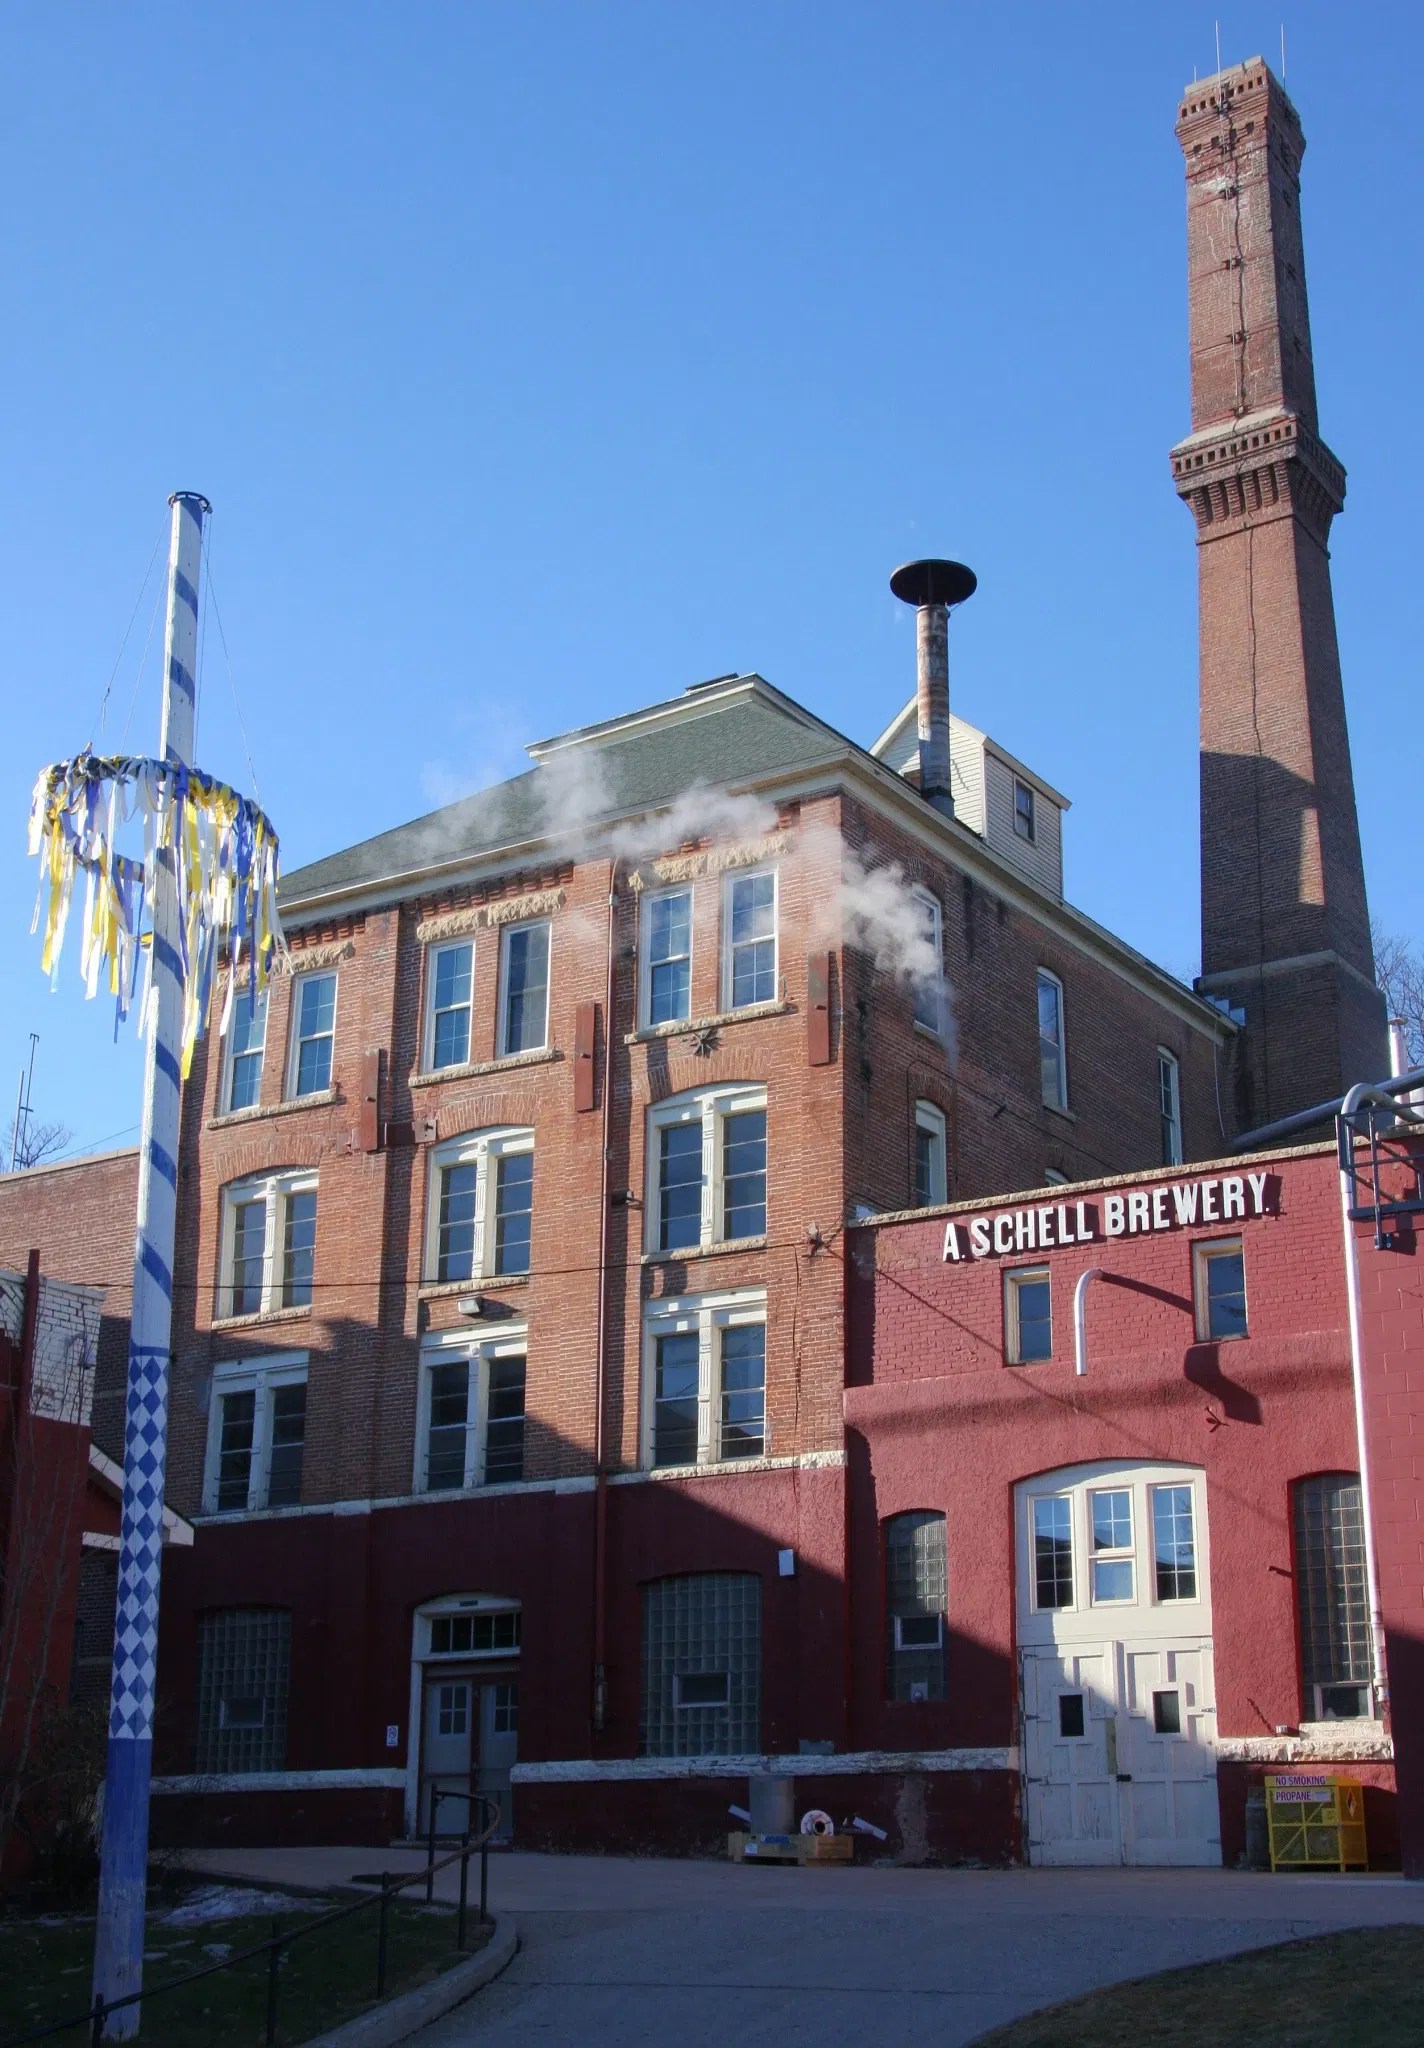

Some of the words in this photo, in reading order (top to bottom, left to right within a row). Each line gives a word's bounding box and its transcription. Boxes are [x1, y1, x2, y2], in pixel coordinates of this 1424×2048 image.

[943, 1223, 966, 1261] A.
[971, 1201, 1093, 1257] SCHELL
[1105, 1172, 1270, 1236] BREWERY.
[1275, 1776, 1287, 1786] NO
[1288, 1775, 1326, 1786] SMOKING
[1275, 1791, 1312, 1801] PROPANE
